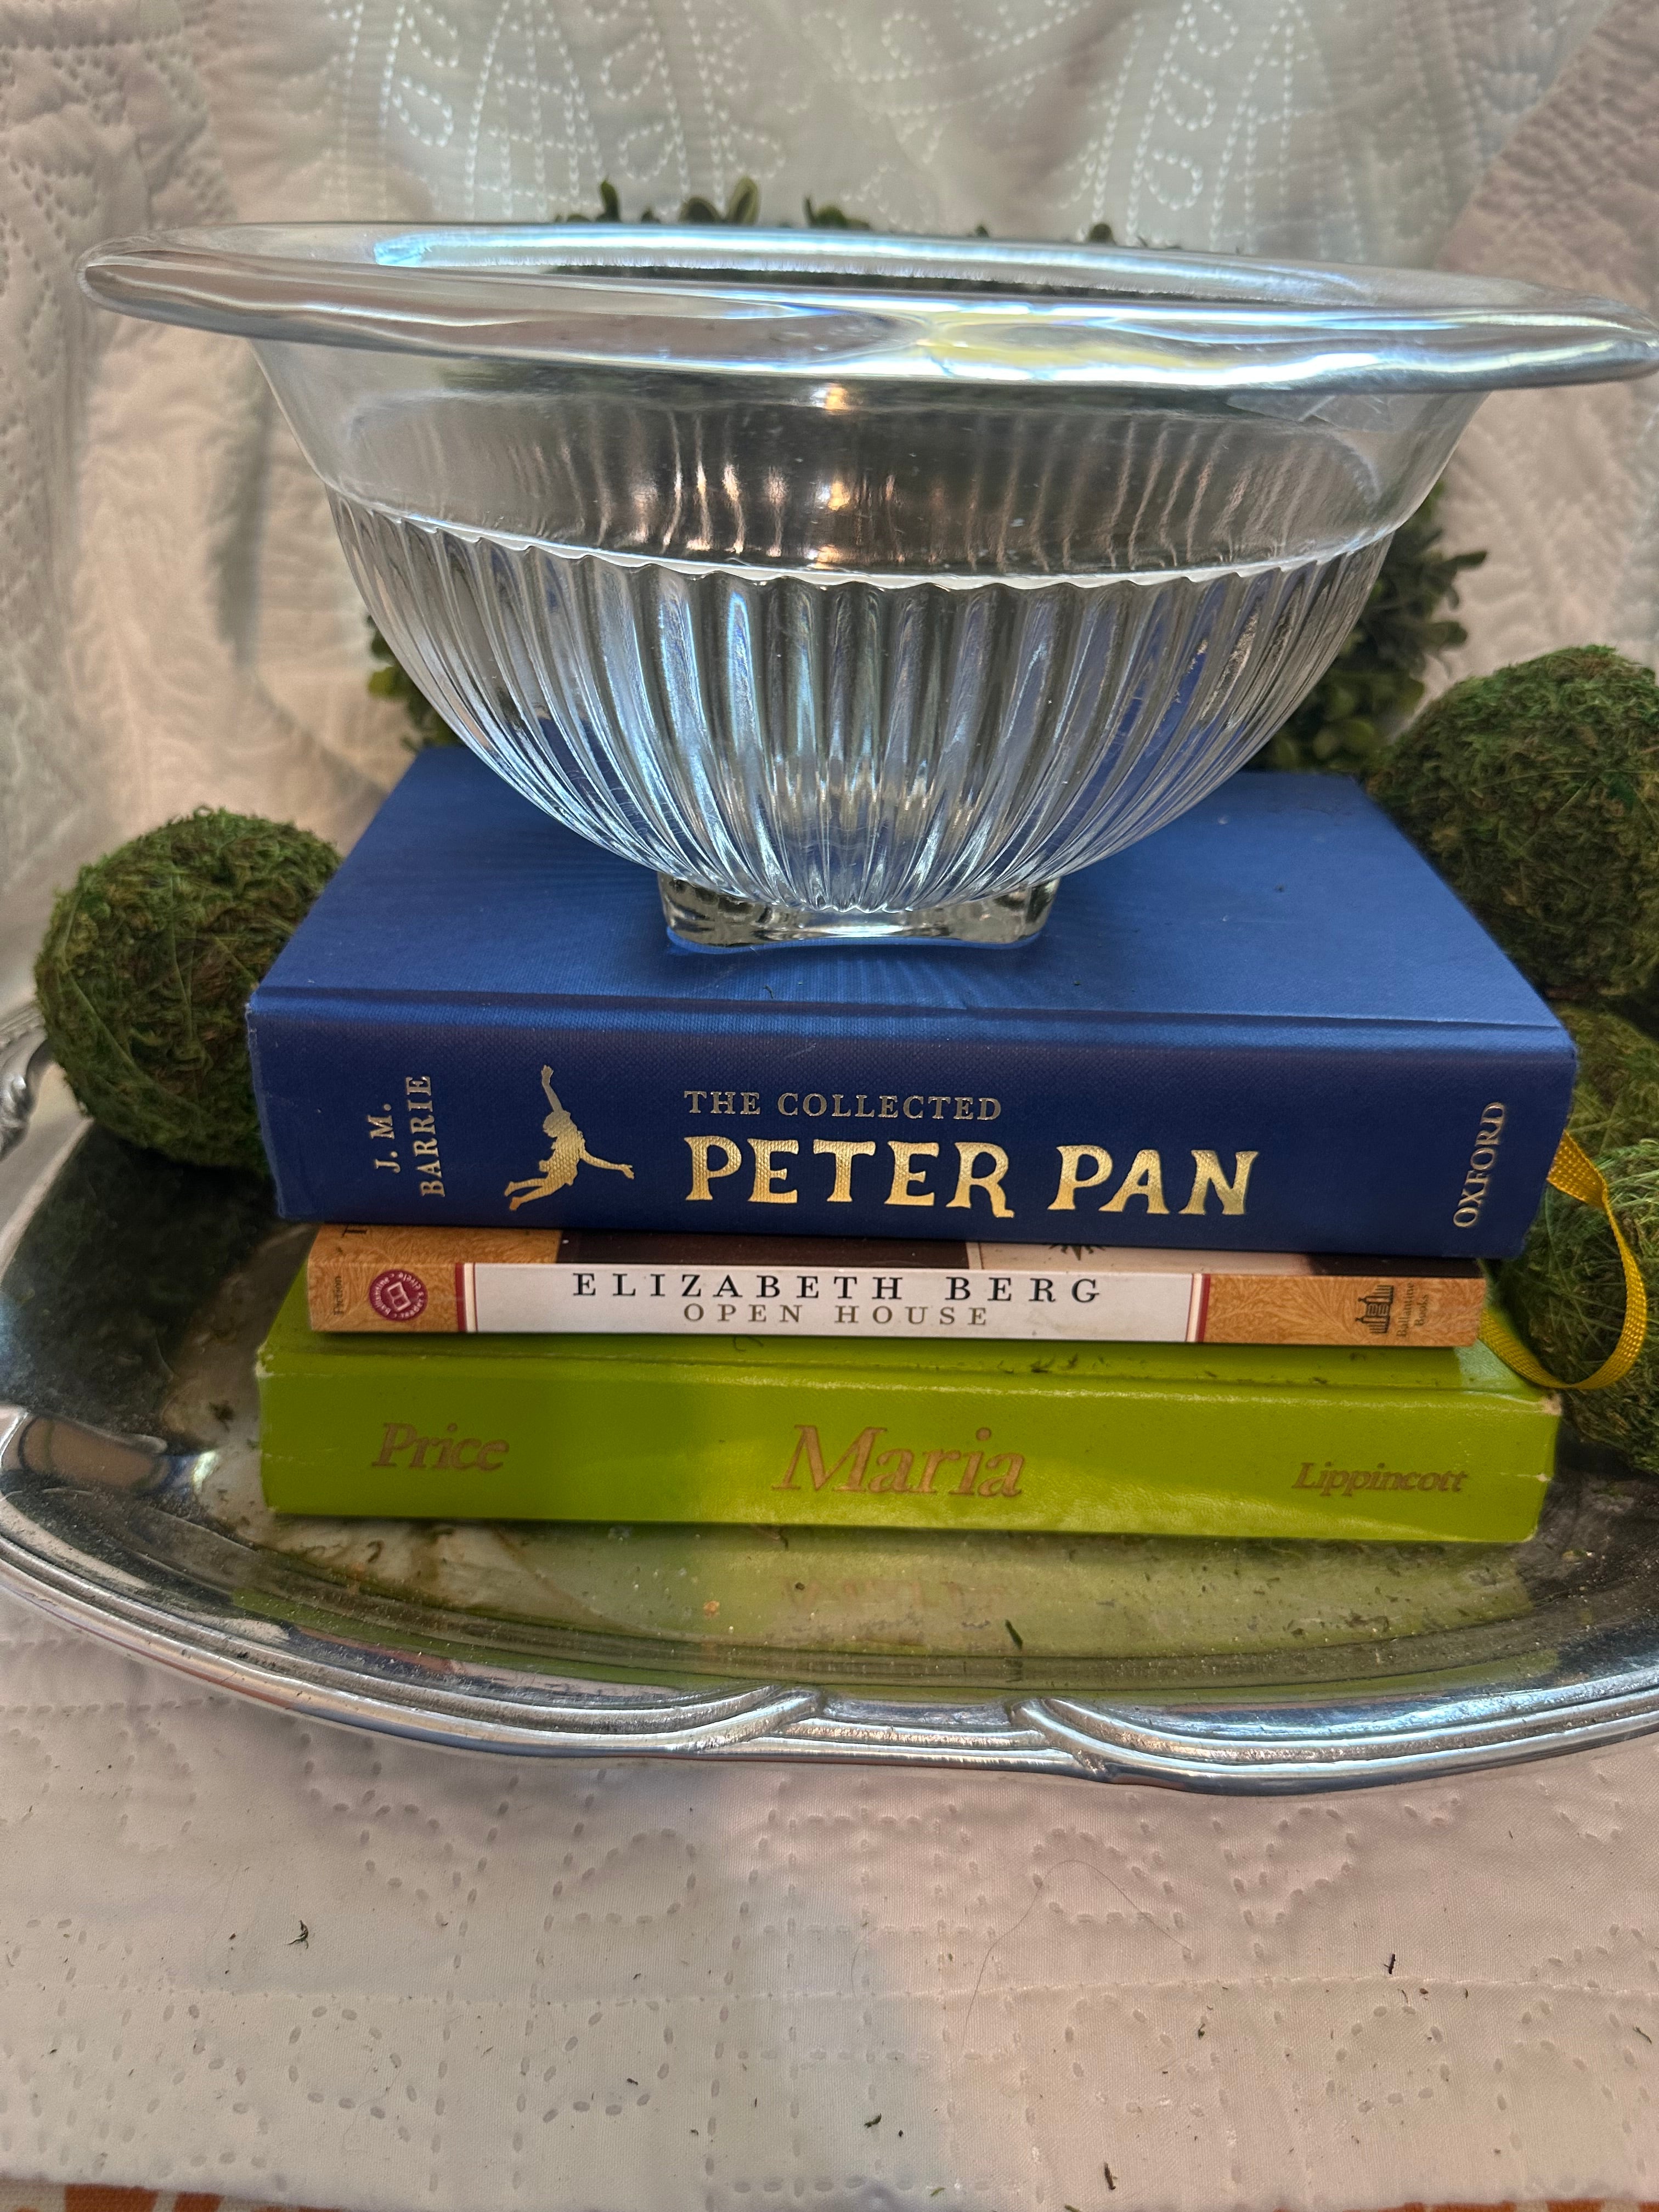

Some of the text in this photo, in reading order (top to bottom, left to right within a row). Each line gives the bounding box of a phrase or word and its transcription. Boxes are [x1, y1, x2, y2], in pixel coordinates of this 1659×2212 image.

[684, 1091, 1002, 1120] THE COLLECTED
[367, 1103, 401, 1173] J. M.
[405, 1076, 445, 1197] BARRIE
[684, 1136, 1259, 1218] PETER PAN
[1453, 1102, 1505, 1228] OXFORD
[572, 1273, 1100, 1303] ELIZABETH BERG
[1396, 1282, 1415, 1338] Ballantine
[1414, 1294, 1429, 1327] Books
[684, 1304, 988, 1326] OPEN HOUSE
[372, 1423, 509, 1471] Price
[771, 1424, 1025, 1497] Maria
[1291, 1461, 1468, 1497] Lippincott
